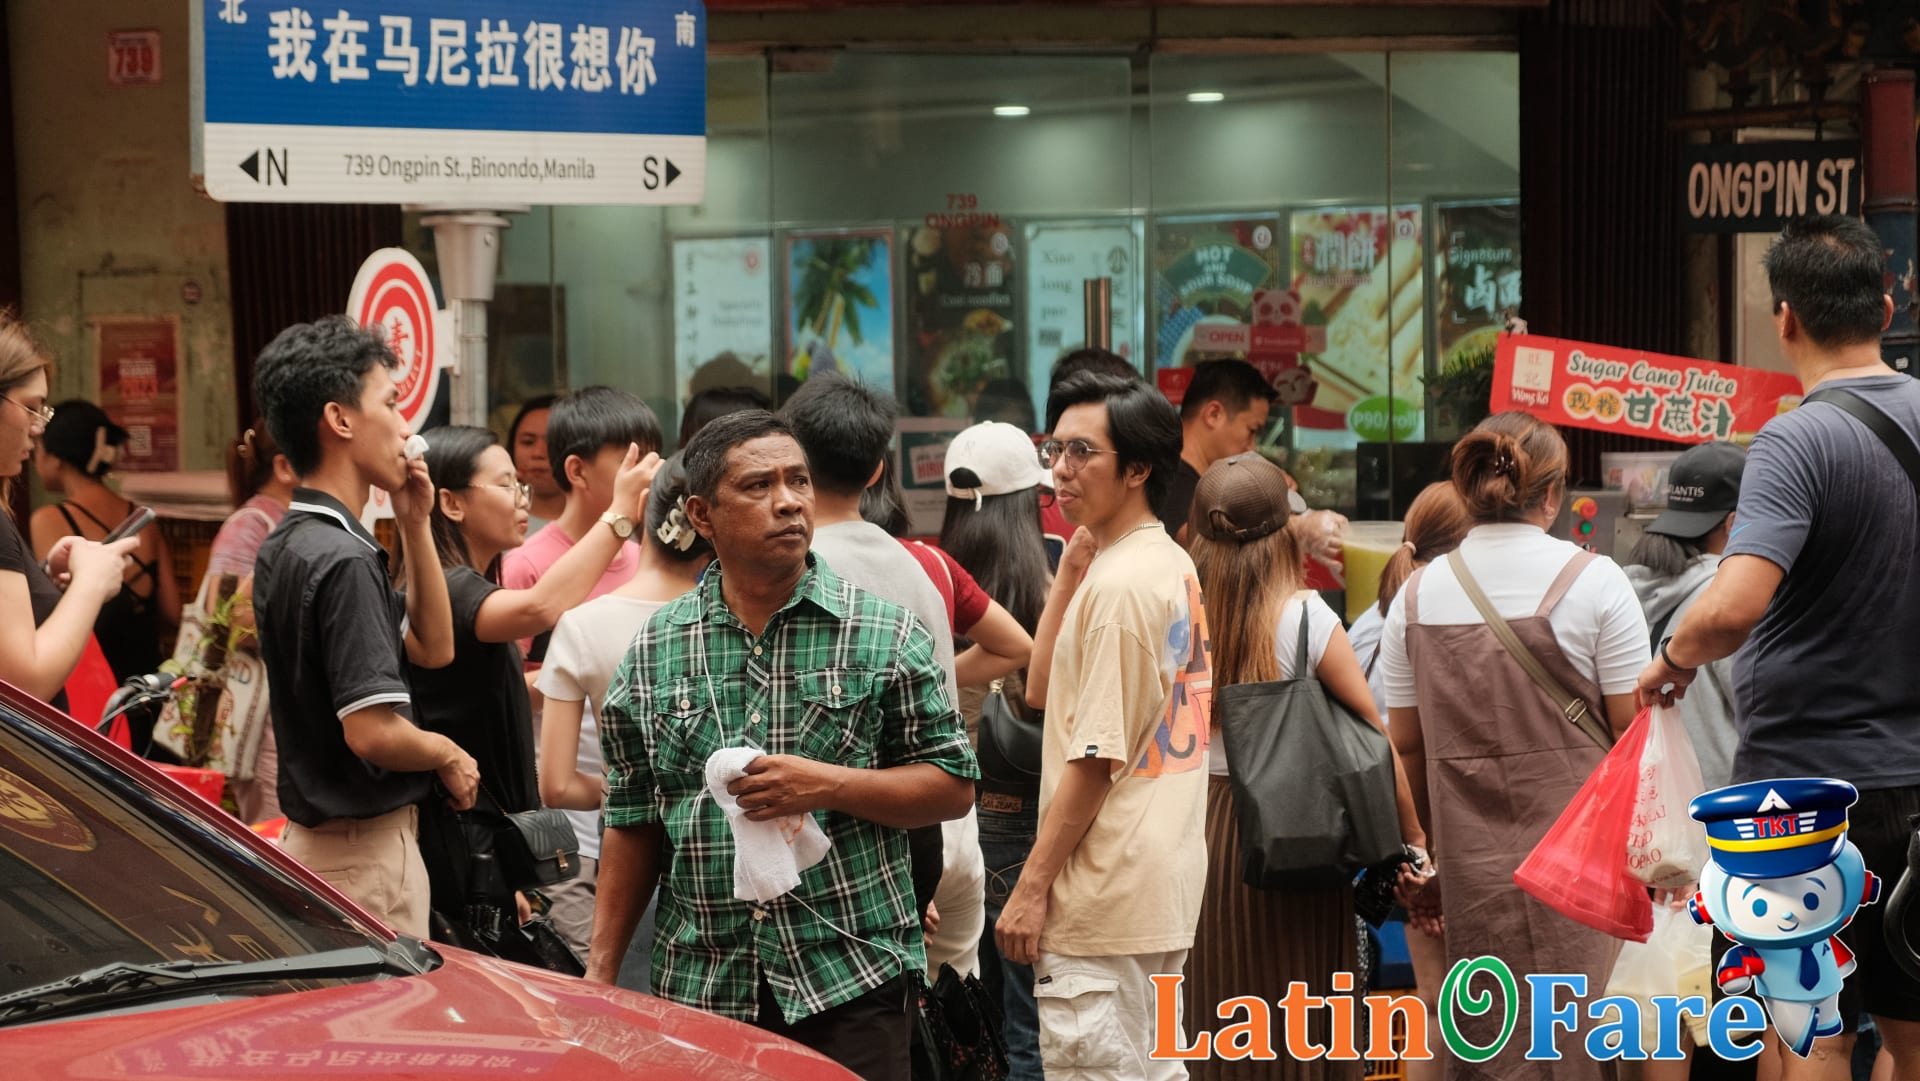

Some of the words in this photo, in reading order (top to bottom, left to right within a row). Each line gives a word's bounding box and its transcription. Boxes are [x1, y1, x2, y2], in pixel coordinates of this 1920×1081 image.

[674, 10, 697, 48] 南
[267, 7, 658, 96] 我在马尼拉很想你
[266, 147, 288, 187] N
[343, 154, 375, 176] 739
[378, 154, 441, 184] Ongpin
[642, 155, 660, 191] S
[946, 193, 978, 209] 739
[1687, 159, 1809, 219] ONGPIN
[1815, 158, 1856, 217] ST
[925, 212, 1000, 228] ONGPIN
[1195, 246, 1234, 265] HOT
[1210, 331, 1245, 343] OPEN
[1568, 352, 1627, 381] Sugar
[1630, 361, 1680, 387] Cane
[1684, 370, 1736, 395] Juice
